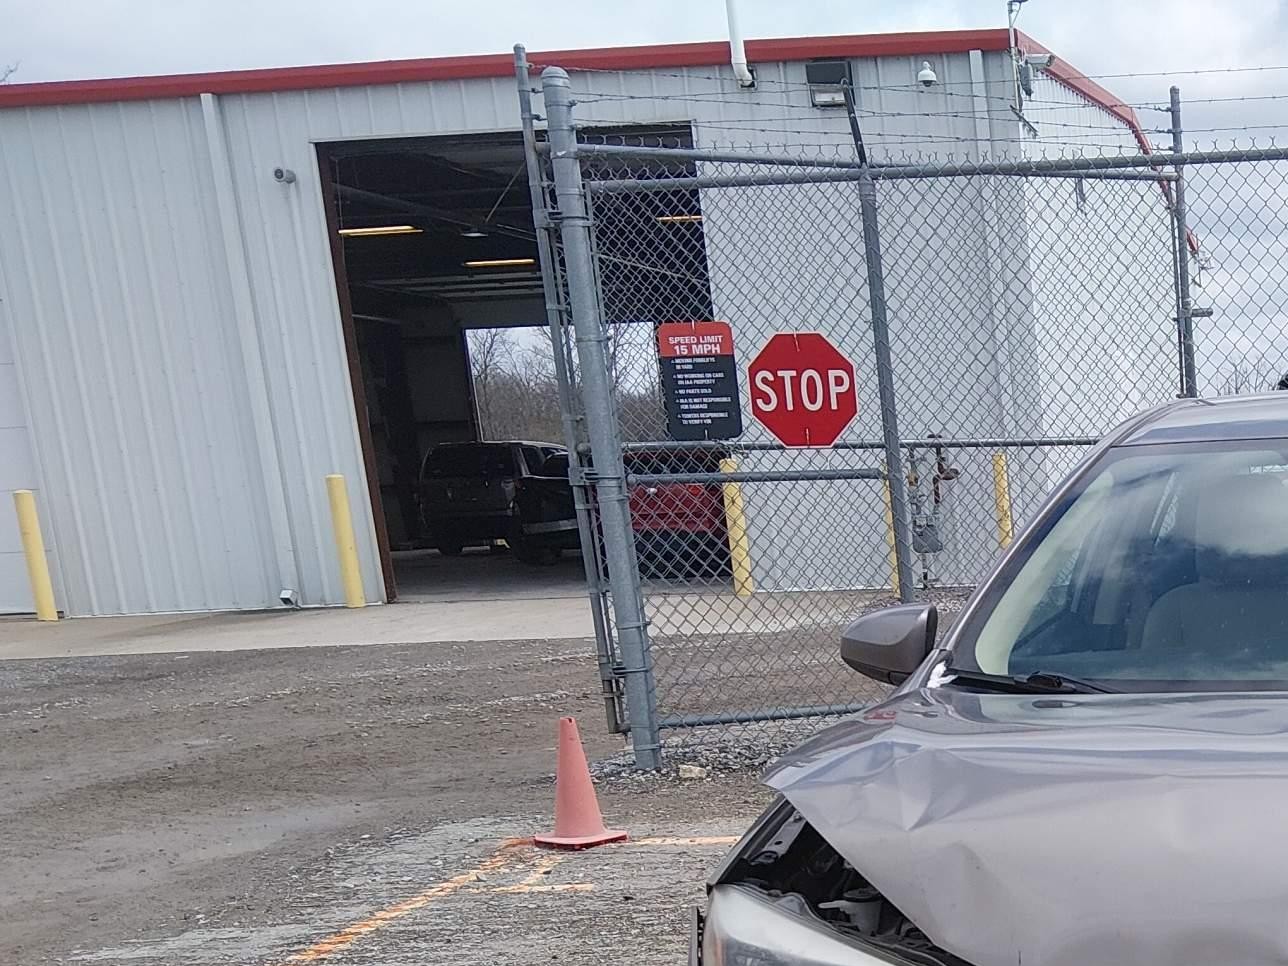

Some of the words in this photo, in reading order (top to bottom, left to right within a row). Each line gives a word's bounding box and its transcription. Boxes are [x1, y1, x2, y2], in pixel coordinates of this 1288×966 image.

[668, 335, 697, 344] SPEED
[699, 335, 723, 344] LIMIT
[674, 345, 688, 355] 15
[692, 344, 720, 354] MPH
[755, 369, 850, 412] STOP
